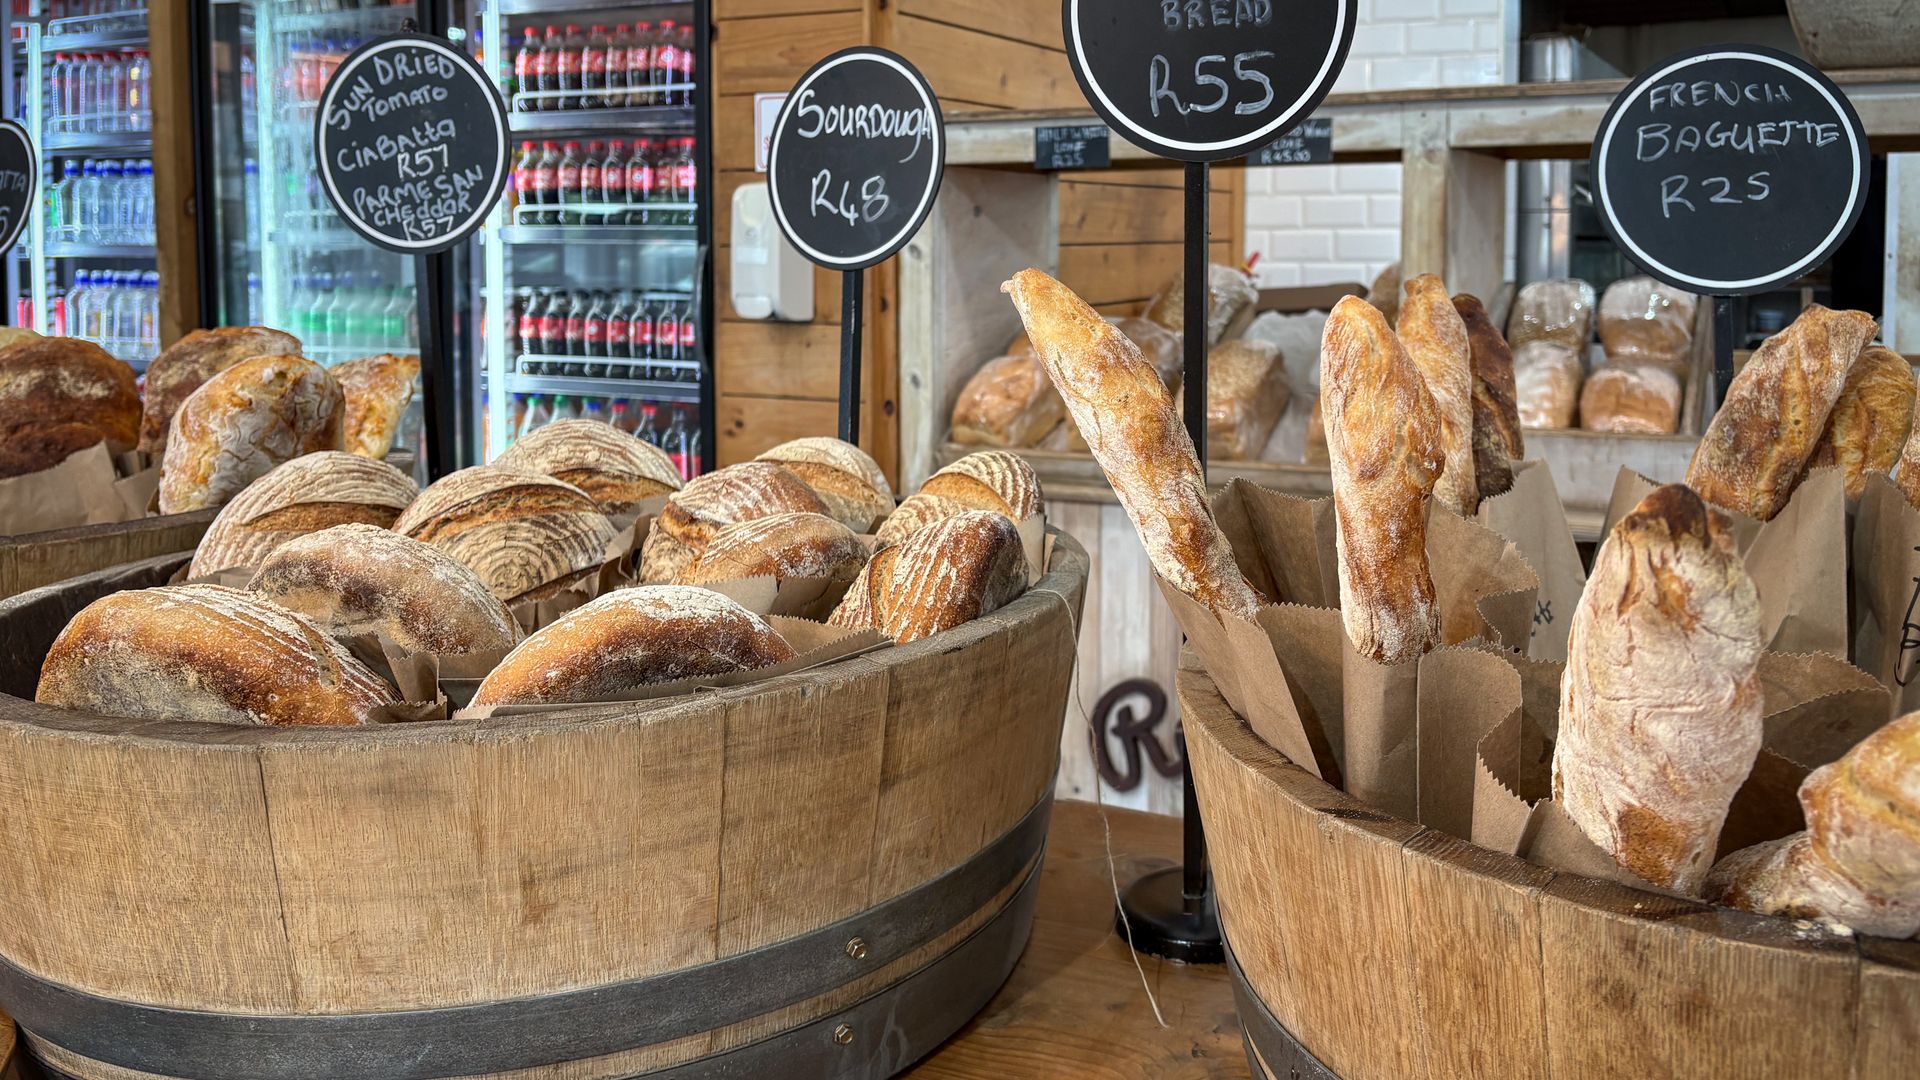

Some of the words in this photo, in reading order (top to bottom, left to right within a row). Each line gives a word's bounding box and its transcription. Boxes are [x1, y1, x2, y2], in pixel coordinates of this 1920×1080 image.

[1161, 0, 1272, 31] BREAD
[327, 75, 374, 130] SUN
[1150, 51, 1275, 120] R55
[1649, 80, 1793, 113] FRENCH
[397, 143, 449, 180] R57
[1636, 120, 1840, 162] BAGUETTE
[810, 168, 889, 227] R48
[1660, 171, 1771, 219] R25
[402, 214, 455, 241] R57
